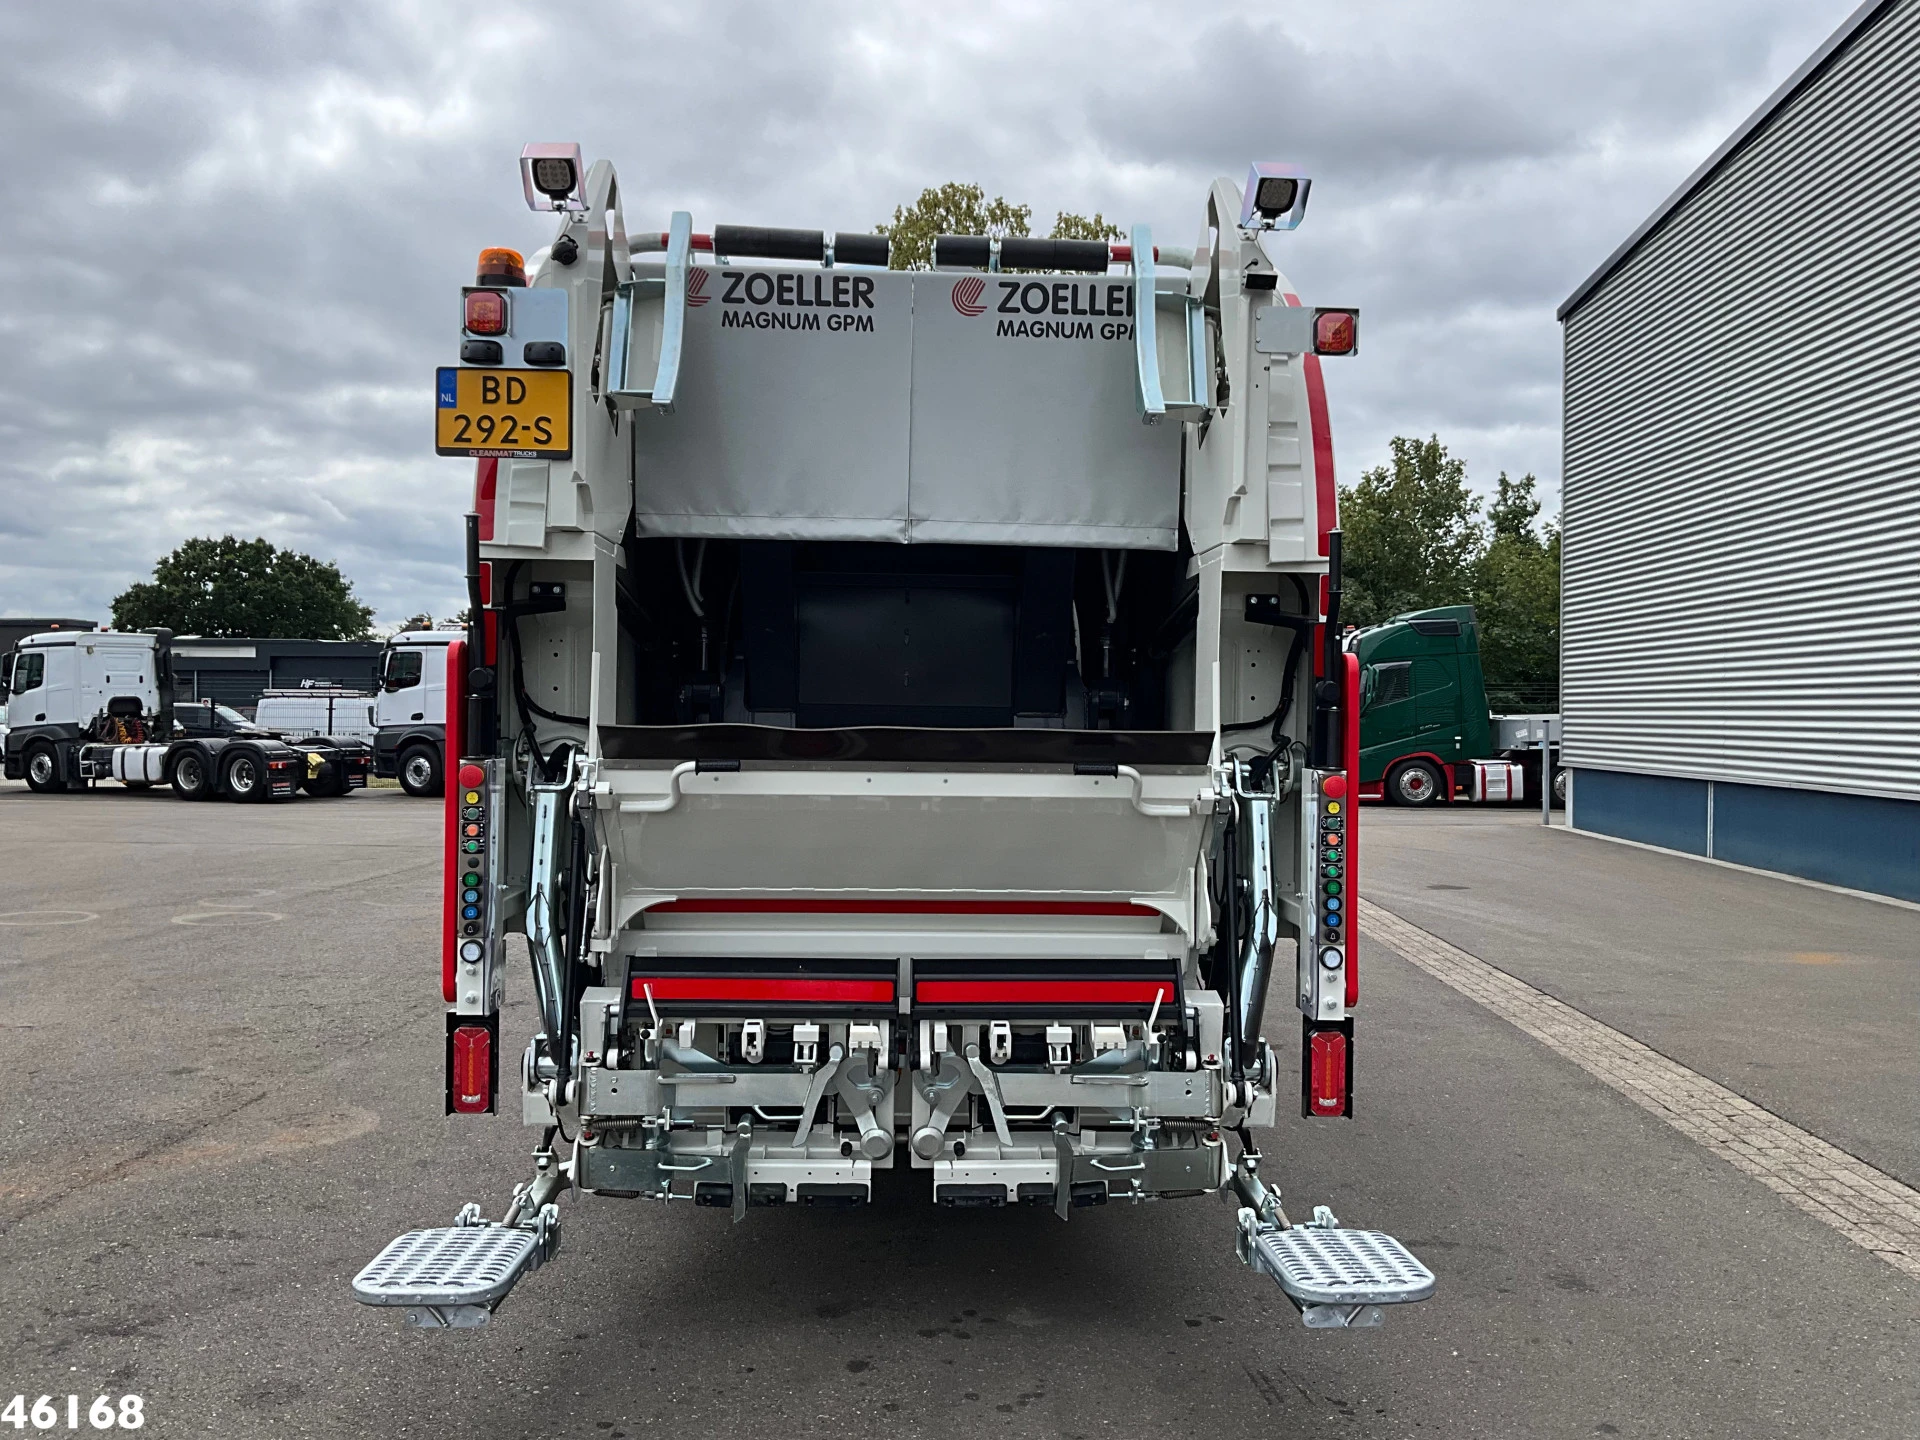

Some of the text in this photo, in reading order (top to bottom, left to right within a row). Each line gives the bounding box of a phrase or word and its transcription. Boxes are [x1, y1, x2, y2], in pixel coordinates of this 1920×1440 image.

[721, 272, 875, 309] ZOELLER
[721, 310, 875, 332] MAGNUM GPM
[996, 319, 1094, 340] MAGNUM
[441, 393, 454, 403] NL
[482, 375, 526, 405] BD
[453, 414, 553, 445] 292-S
[300, 679, 315, 689] HF
